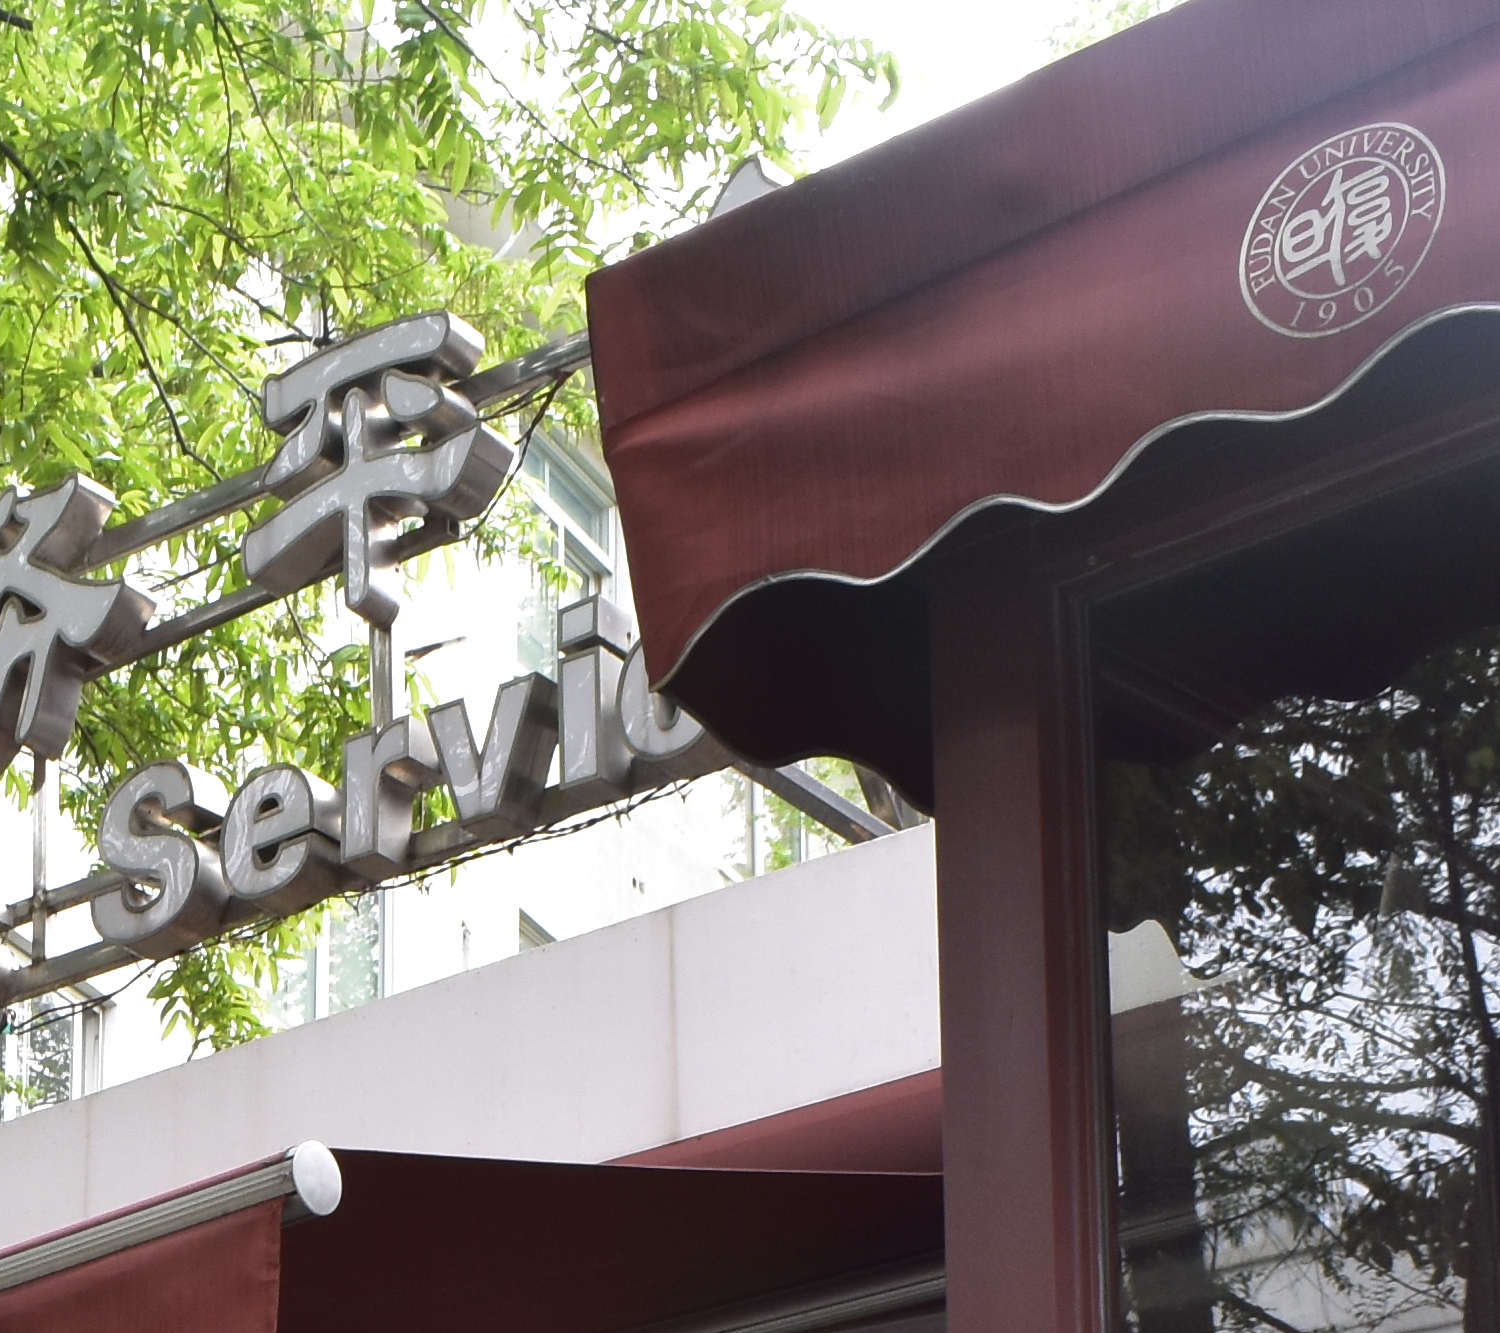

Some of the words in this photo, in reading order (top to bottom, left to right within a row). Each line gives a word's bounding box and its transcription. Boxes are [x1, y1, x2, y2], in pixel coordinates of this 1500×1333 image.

[1248, 185, 1296, 297] FUDAN
[1299, 129, 1433, 221] UNIVERSITY
[1289, 257, 1405, 328] 1905
